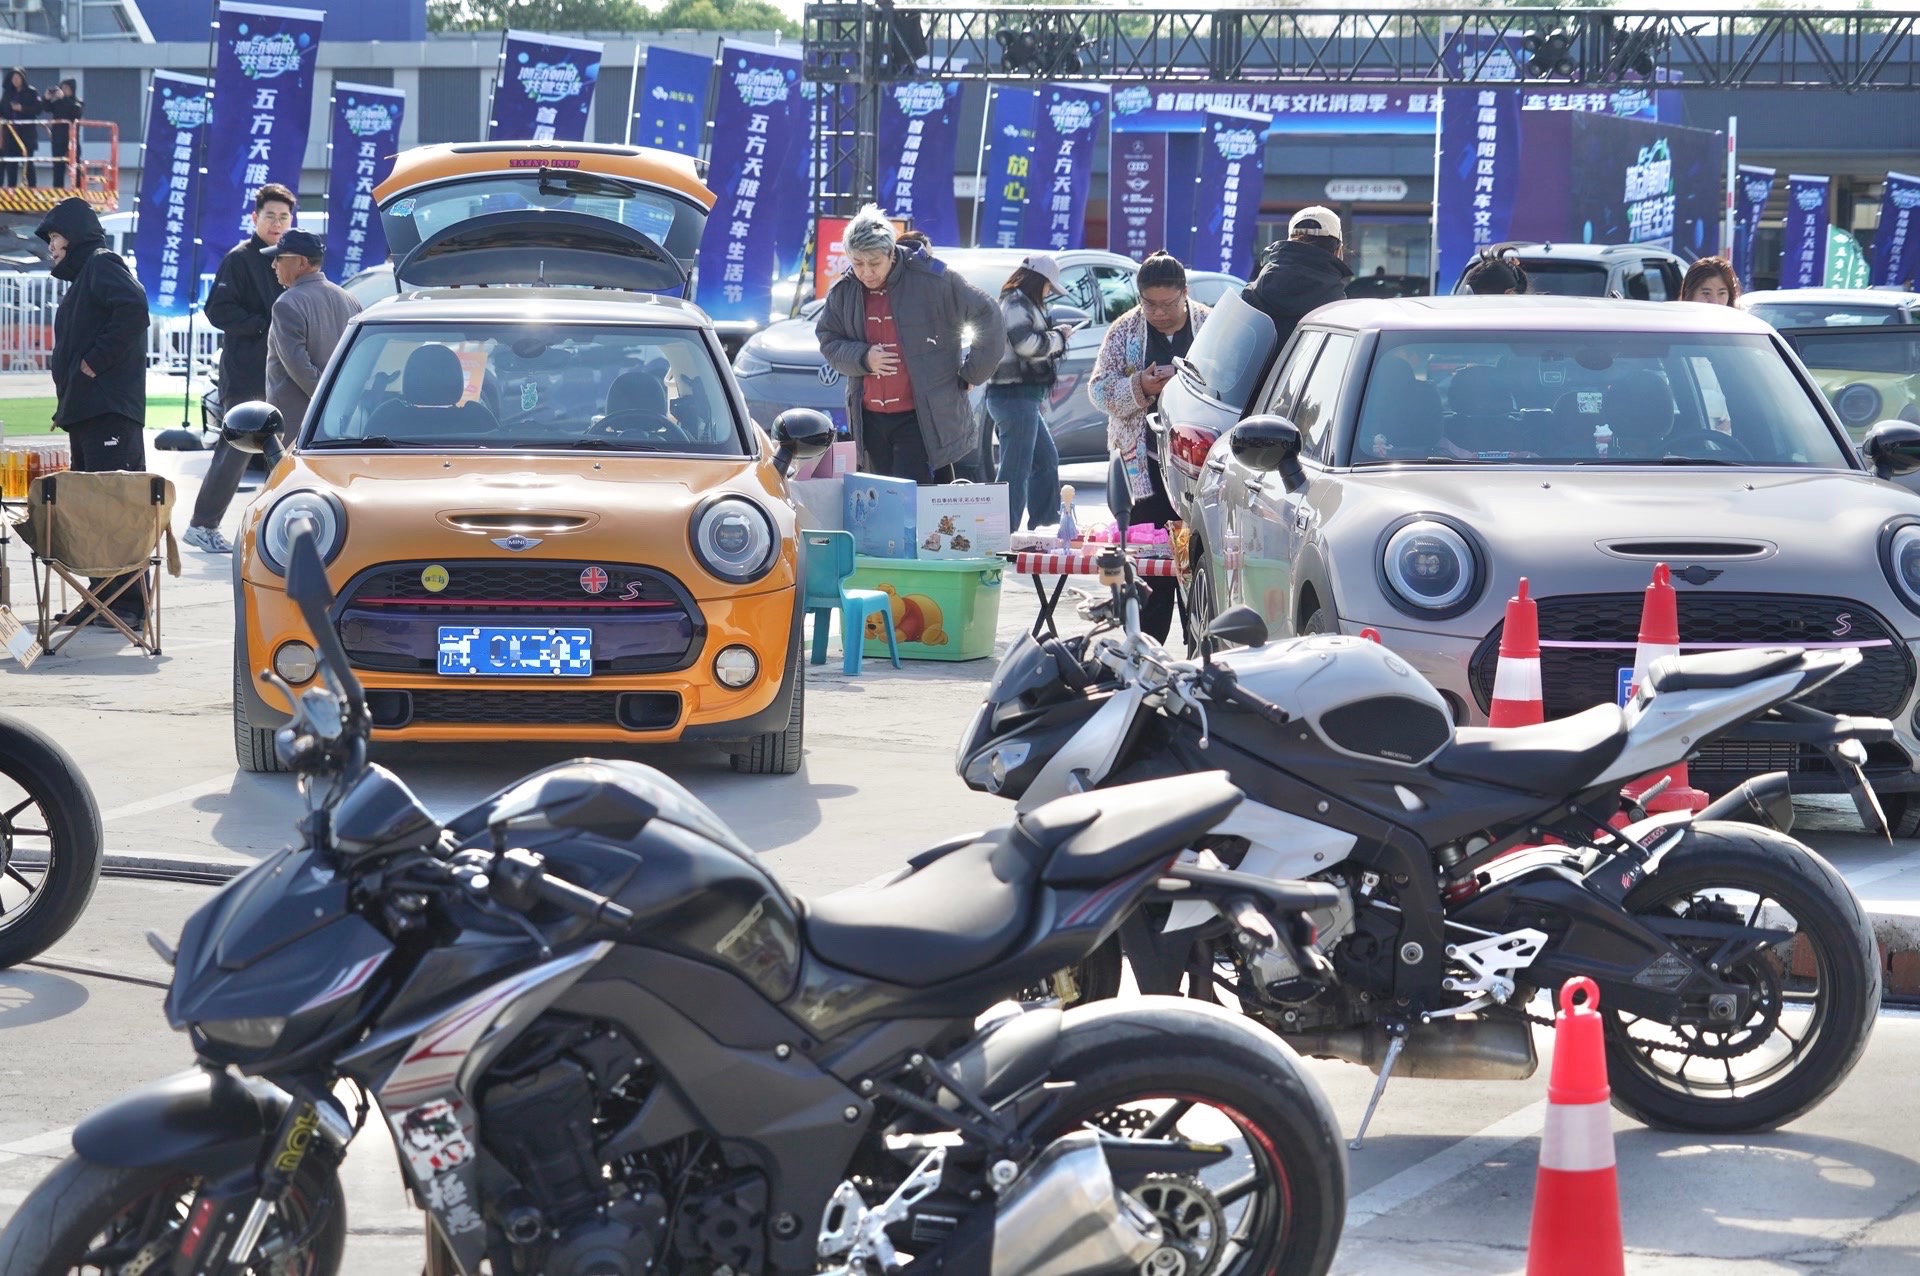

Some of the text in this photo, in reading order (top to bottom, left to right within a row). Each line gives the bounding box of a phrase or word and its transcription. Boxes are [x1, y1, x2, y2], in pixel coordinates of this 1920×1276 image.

[234, 39, 296, 55] 潮动朝阳
[241, 54, 301, 71] 共营生活
[523, 80, 582, 97] 共营生活
[1522, 93, 1608, 111] 车生活节
[895, 119, 925, 218] 首届朝阳区汽
[157, 131, 193, 308] 首届朝阳区汽车文化消费季
[723, 114, 769, 305] 五方天雅汽车生活节
[619, 581, 642, 601] S
[1832, 612, 1851, 636] S
